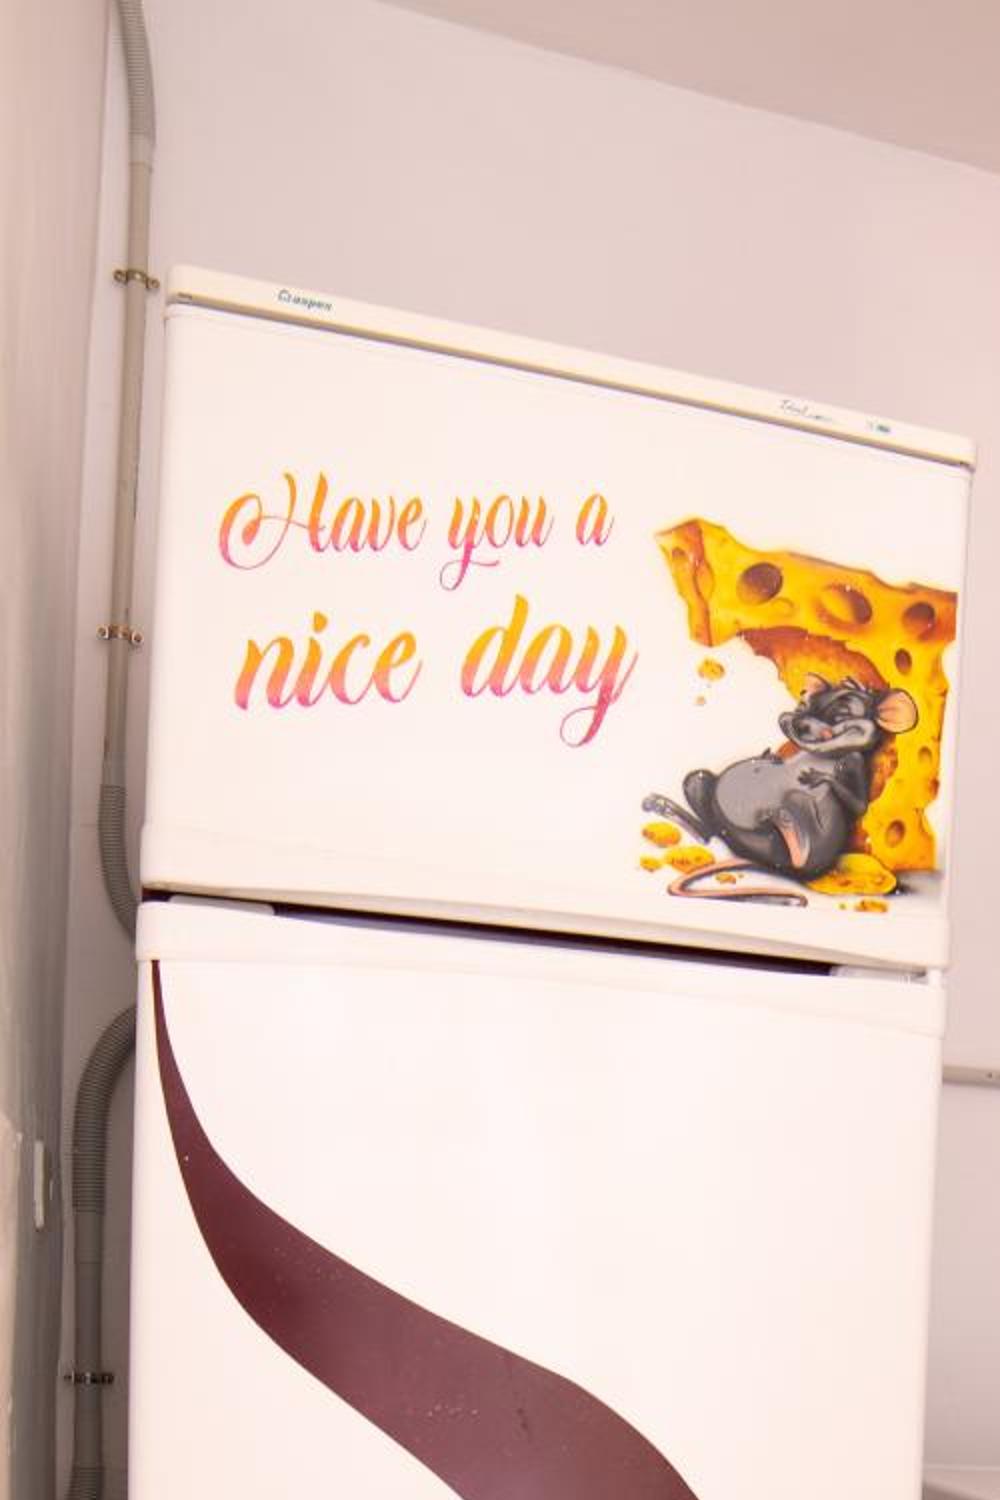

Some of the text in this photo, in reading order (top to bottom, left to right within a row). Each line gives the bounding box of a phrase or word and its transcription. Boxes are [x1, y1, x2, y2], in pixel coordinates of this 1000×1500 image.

[218, 470, 615, 591] Have you a
[234, 594, 639, 748] nice day
